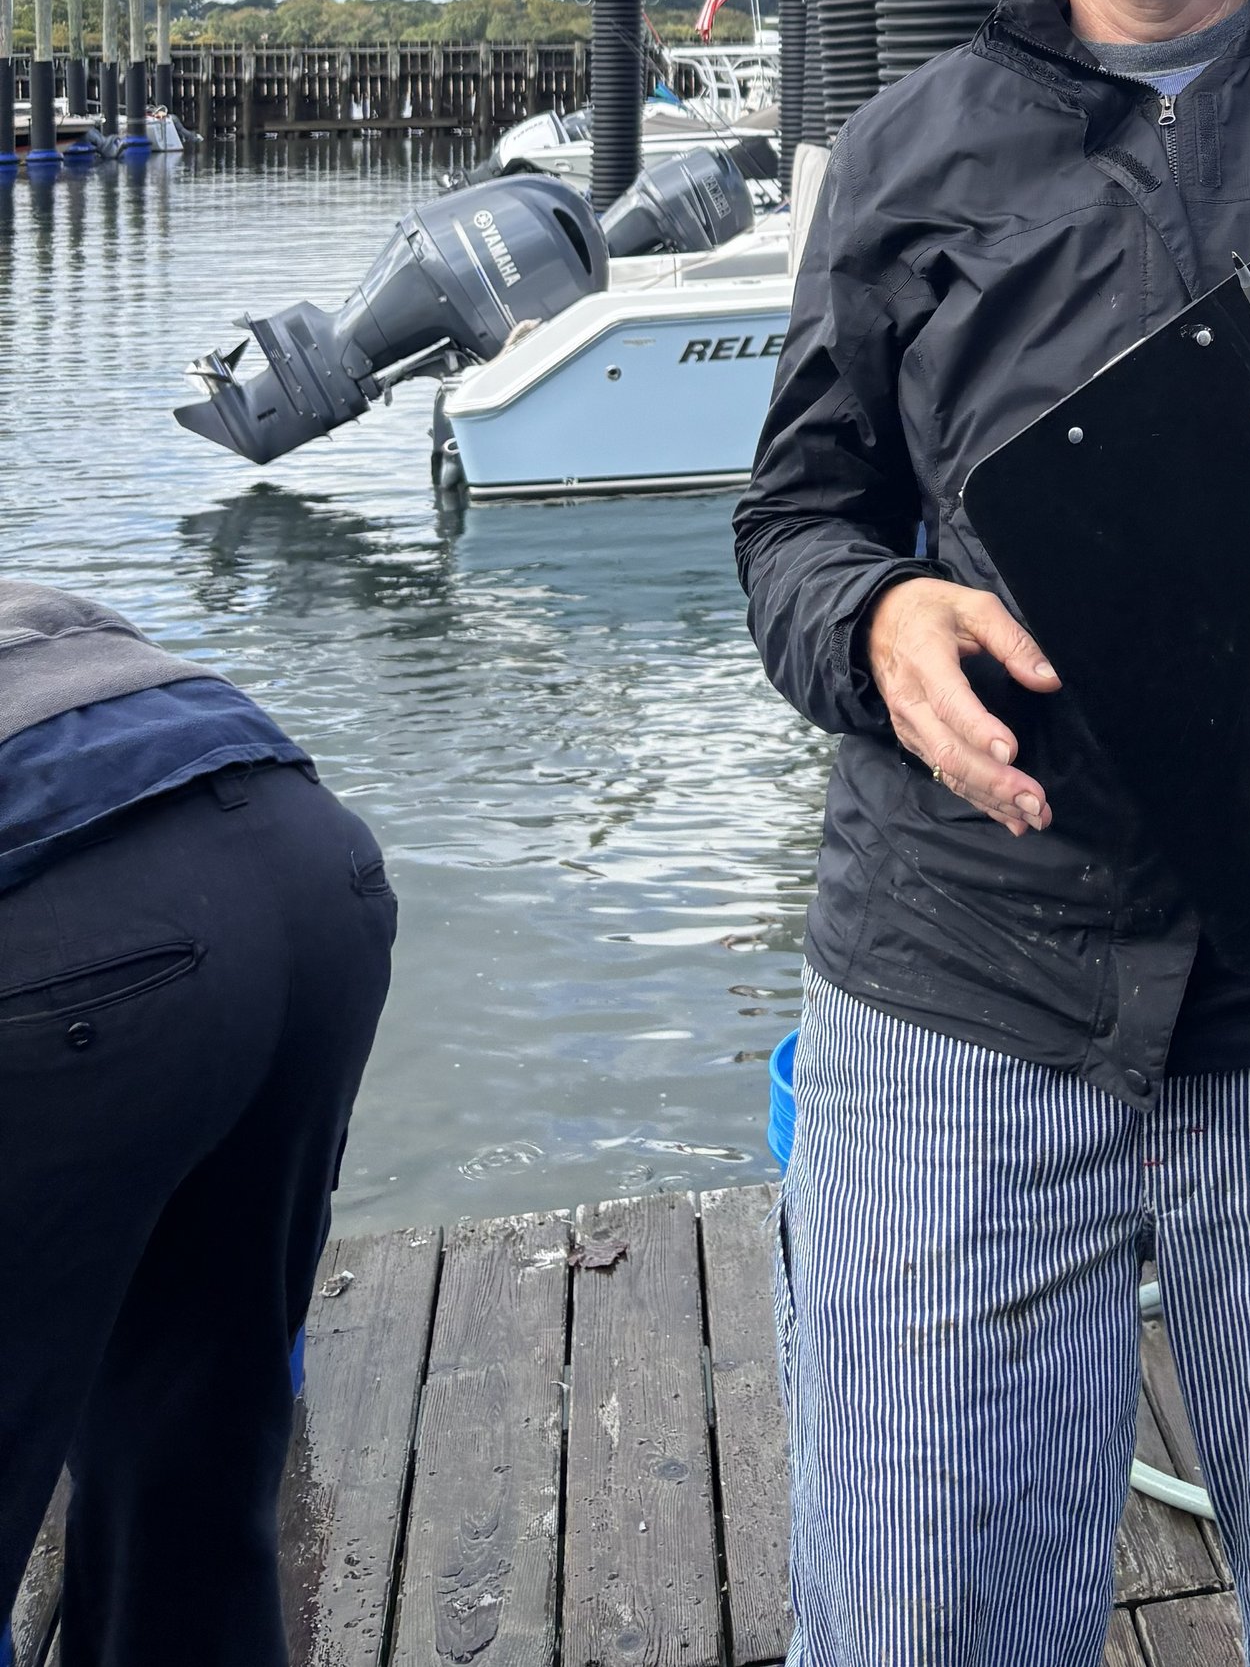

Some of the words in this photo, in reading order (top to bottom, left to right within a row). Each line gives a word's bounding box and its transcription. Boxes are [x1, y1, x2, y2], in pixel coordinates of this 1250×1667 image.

[702, 174, 731, 219] YAMAHA
[481, 223, 521, 287] YAMAHA
[679, 334, 787, 364] RELE
